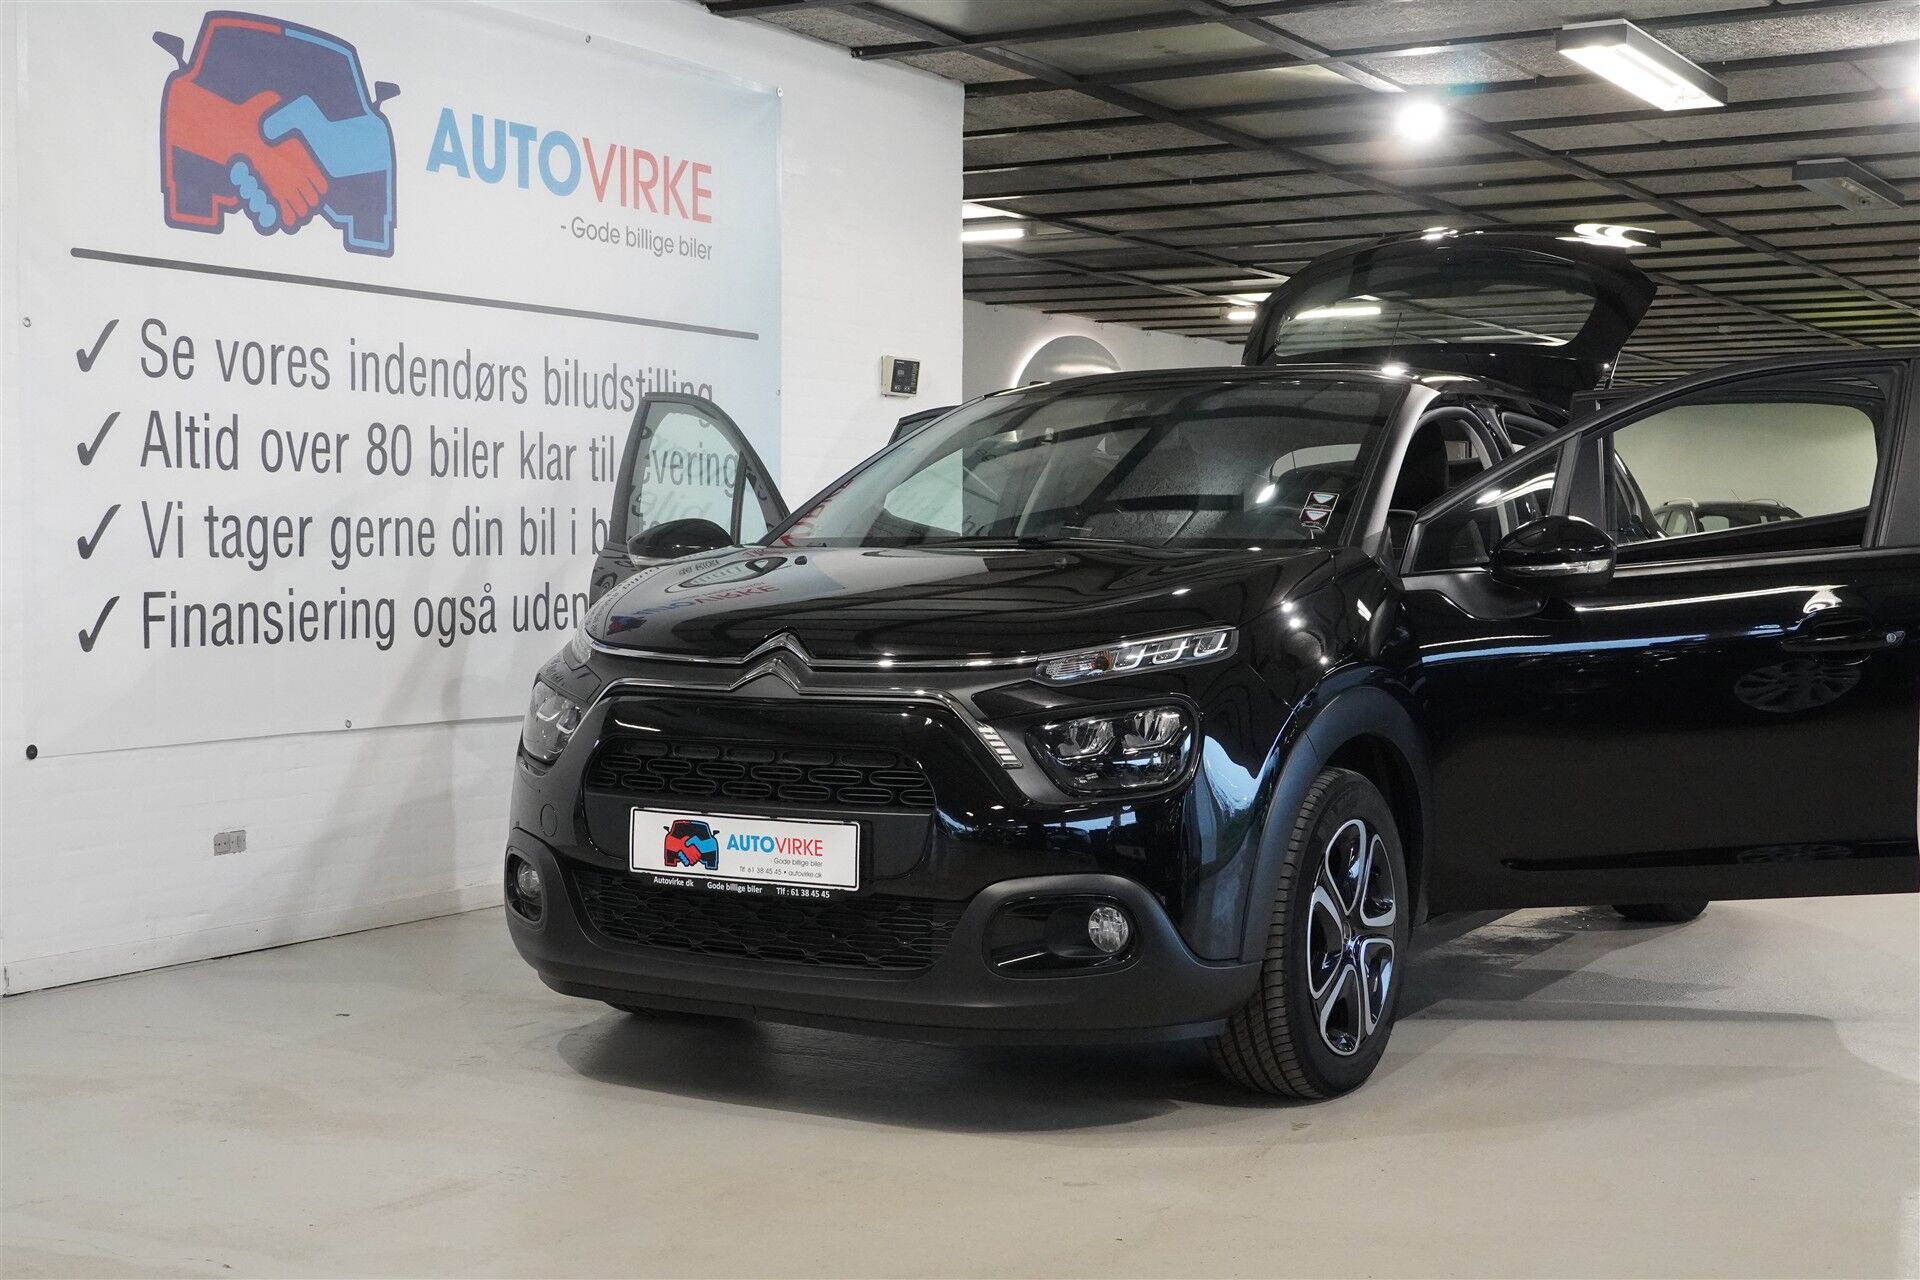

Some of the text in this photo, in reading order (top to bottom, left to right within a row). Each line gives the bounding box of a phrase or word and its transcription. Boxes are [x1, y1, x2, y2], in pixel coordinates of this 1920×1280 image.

[425, 106, 712, 224] AUTOVIRKE
[571, 216, 621, 244] Gode
[625, 225, 675, 257] billige
[679, 235, 712, 260] biler
[140, 318, 195, 380] Se
[215, 339, 331, 390] vores
[350, 338, 528, 404] indendørs
[140, 410, 239, 471] Altid
[260, 429, 350, 473] over
[366, 422, 412, 476] 80
[430, 425, 505, 479] biler
[519, 430, 577, 482] klar
[588, 435, 615, 482] til
[141, 500, 184, 558] Vi
[203, 505, 313, 571] tager
[330, 515, 436, 570] gerne
[452, 505, 503, 557] din
[520, 506, 555, 556] bil
[571, 507, 576, 555] i
[143, 581, 589, 651] Finansiering også uden
[726, 833, 823, 857] AUTOVIRKE
[756, 866, 764, 874] 38
[765, 867, 773, 875] 45
[774, 868, 782, 876] 45
[773, 857, 791, 865] Gode
[792, 859, 809, 868] billige
[653, 876, 694, 887] Autovirke dk
[707, 881, 763, 894] Gode billige biler
[790, 888, 799, 896] 61
[801, 889, 810, 897] 38
[811, 889, 820, 898] 45
[821, 890, 830, 899] 45
